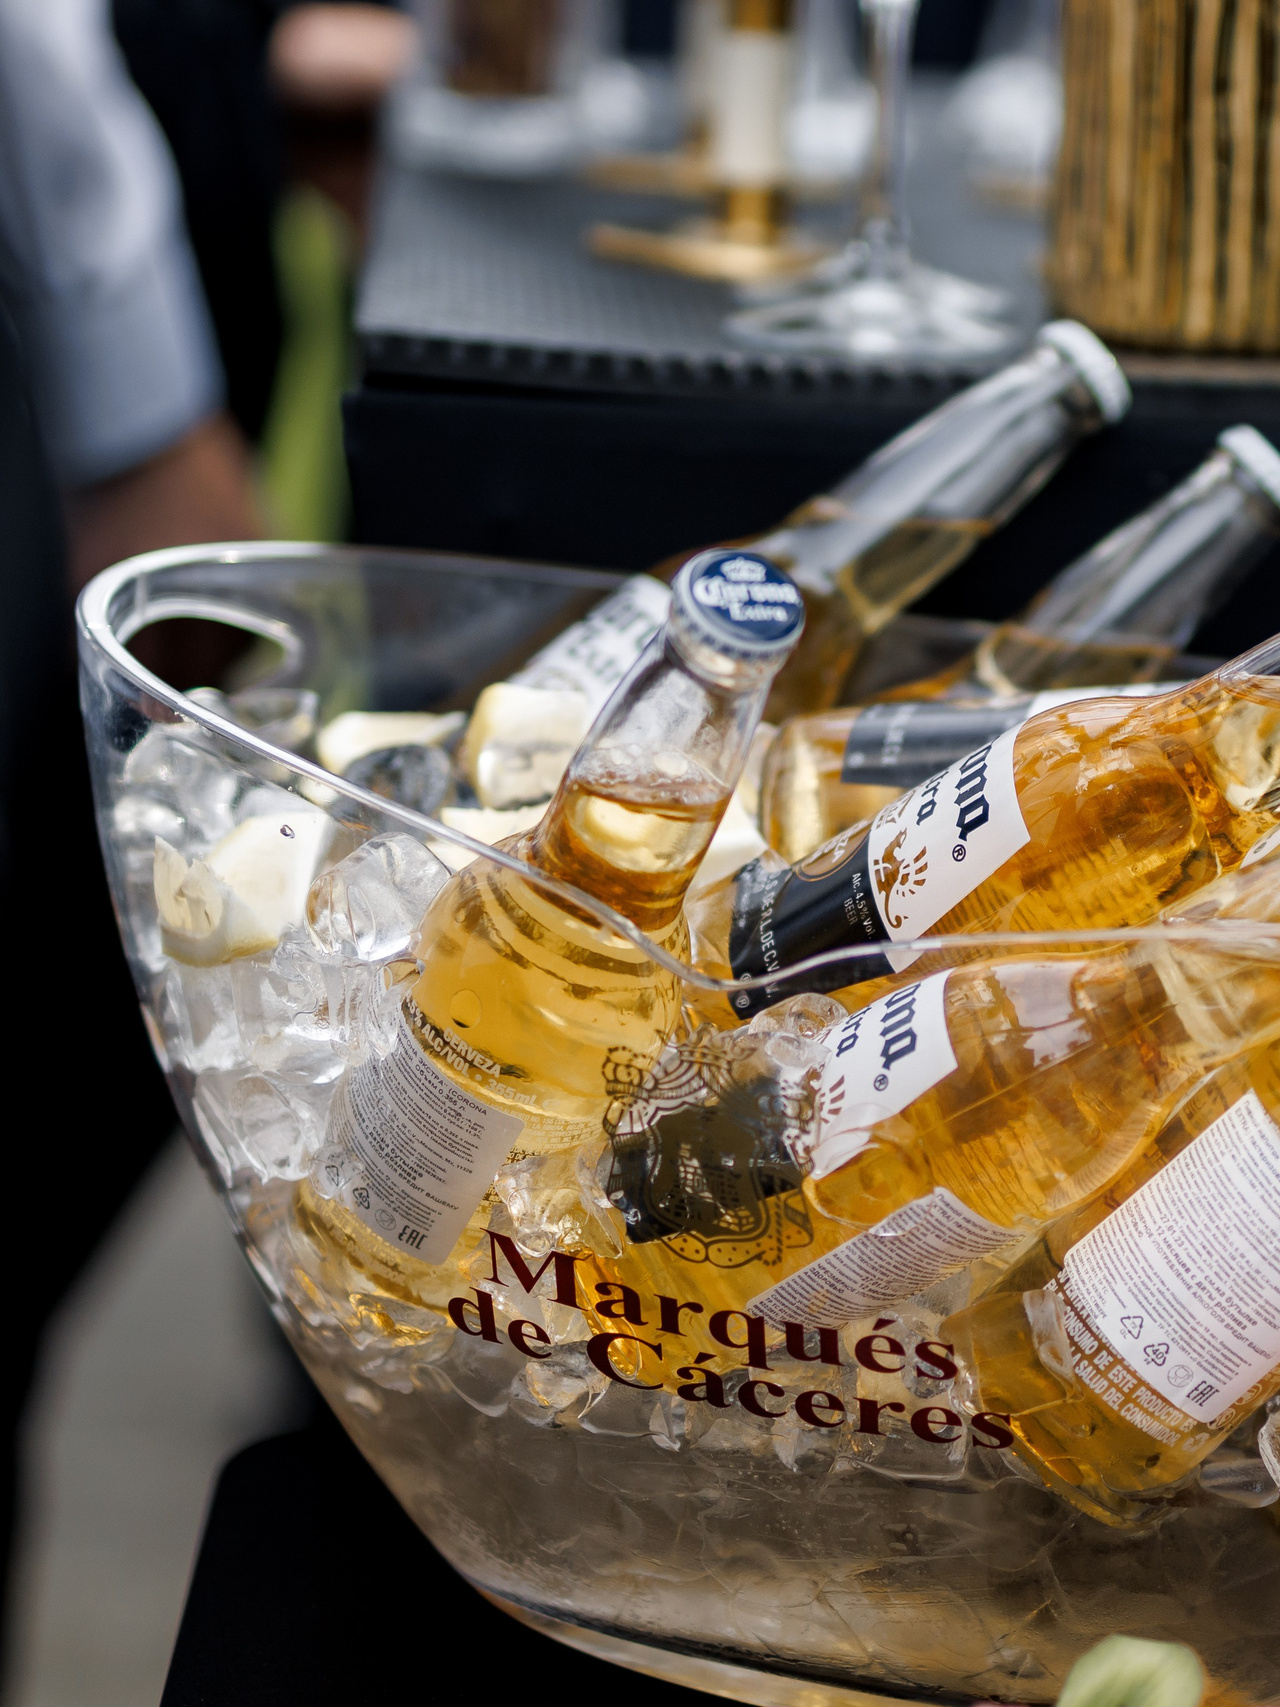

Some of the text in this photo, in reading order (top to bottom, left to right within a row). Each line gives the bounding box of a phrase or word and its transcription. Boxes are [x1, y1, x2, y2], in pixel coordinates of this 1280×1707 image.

[916, 770, 949, 826] tra
[954, 744, 992, 842] ona
[844, 898, 858, 925] BEER
[421, 1025, 470, 1079] ALC/VOL
[836, 1005, 873, 1058] tra
[879, 981, 922, 1071] ona
[413, 1064, 438, 1090] Объем
[441, 1027, 502, 1079] CERVEZA
[417, 1057, 448, 1088] ЭКСТРА"
[447, 1087, 488, 1116] (CORONA
[1234, 1107, 1252, 1135] EXTRA)
[1242, 1100, 1260, 1128] Пивной
[1256, 1128, 1280, 1161] напиток
[367, 1131, 386, 1152] даты
[384, 1151, 417, 1182] розлива
[389, 1147, 424, 1179] бутылке
[356, 1191, 367, 1203] 40
[397, 1172, 424, 1194] ВРЕДИТ
[424, 1191, 459, 1212] ВАШЕМУ
[935, 1192, 988, 1234] Пивной напиток
[398, 1224, 428, 1250] EAC
[1124, 1201, 1145, 1240] ЗДОРОВЬЮ.
[809, 1266, 845, 1296] ЗДОРОВЬЮ.
[1130, 1197, 1271, 1361] ЧРЕЗМЕРНОЕ УПОТРЕБЛЕНИЕ АЛКОГОЛЯ ВРЕДИТ ВАШЕМУ
[1155, 1225, 1165, 1237] 12
[1161, 1236, 1191, 1274] месяцев
[1194, 1280, 1216, 1301] даты
[1214, 1300, 1247, 1331] розлива
[1159, 1212, 1185, 1247] 27.01.23
[1203, 1274, 1226, 1297] см.на
[1224, 1295, 1258, 1327] бутылке
[479, 1227, 958, 1380] Marqués
[447, 1286, 1016, 1450] de Cáceres
[1063, 1305, 1198, 1433] CONSUMO DE ESTE PRODUCTO ES
[1151, 1347, 1164, 1360] 40
[1074, 1359, 1109, 1396] SALUD
[1101, 1386, 1125, 1412] DEL
[1120, 1403, 1182, 1448] CONSUMIDOR
[1186, 1380, 1220, 1407] EAC
